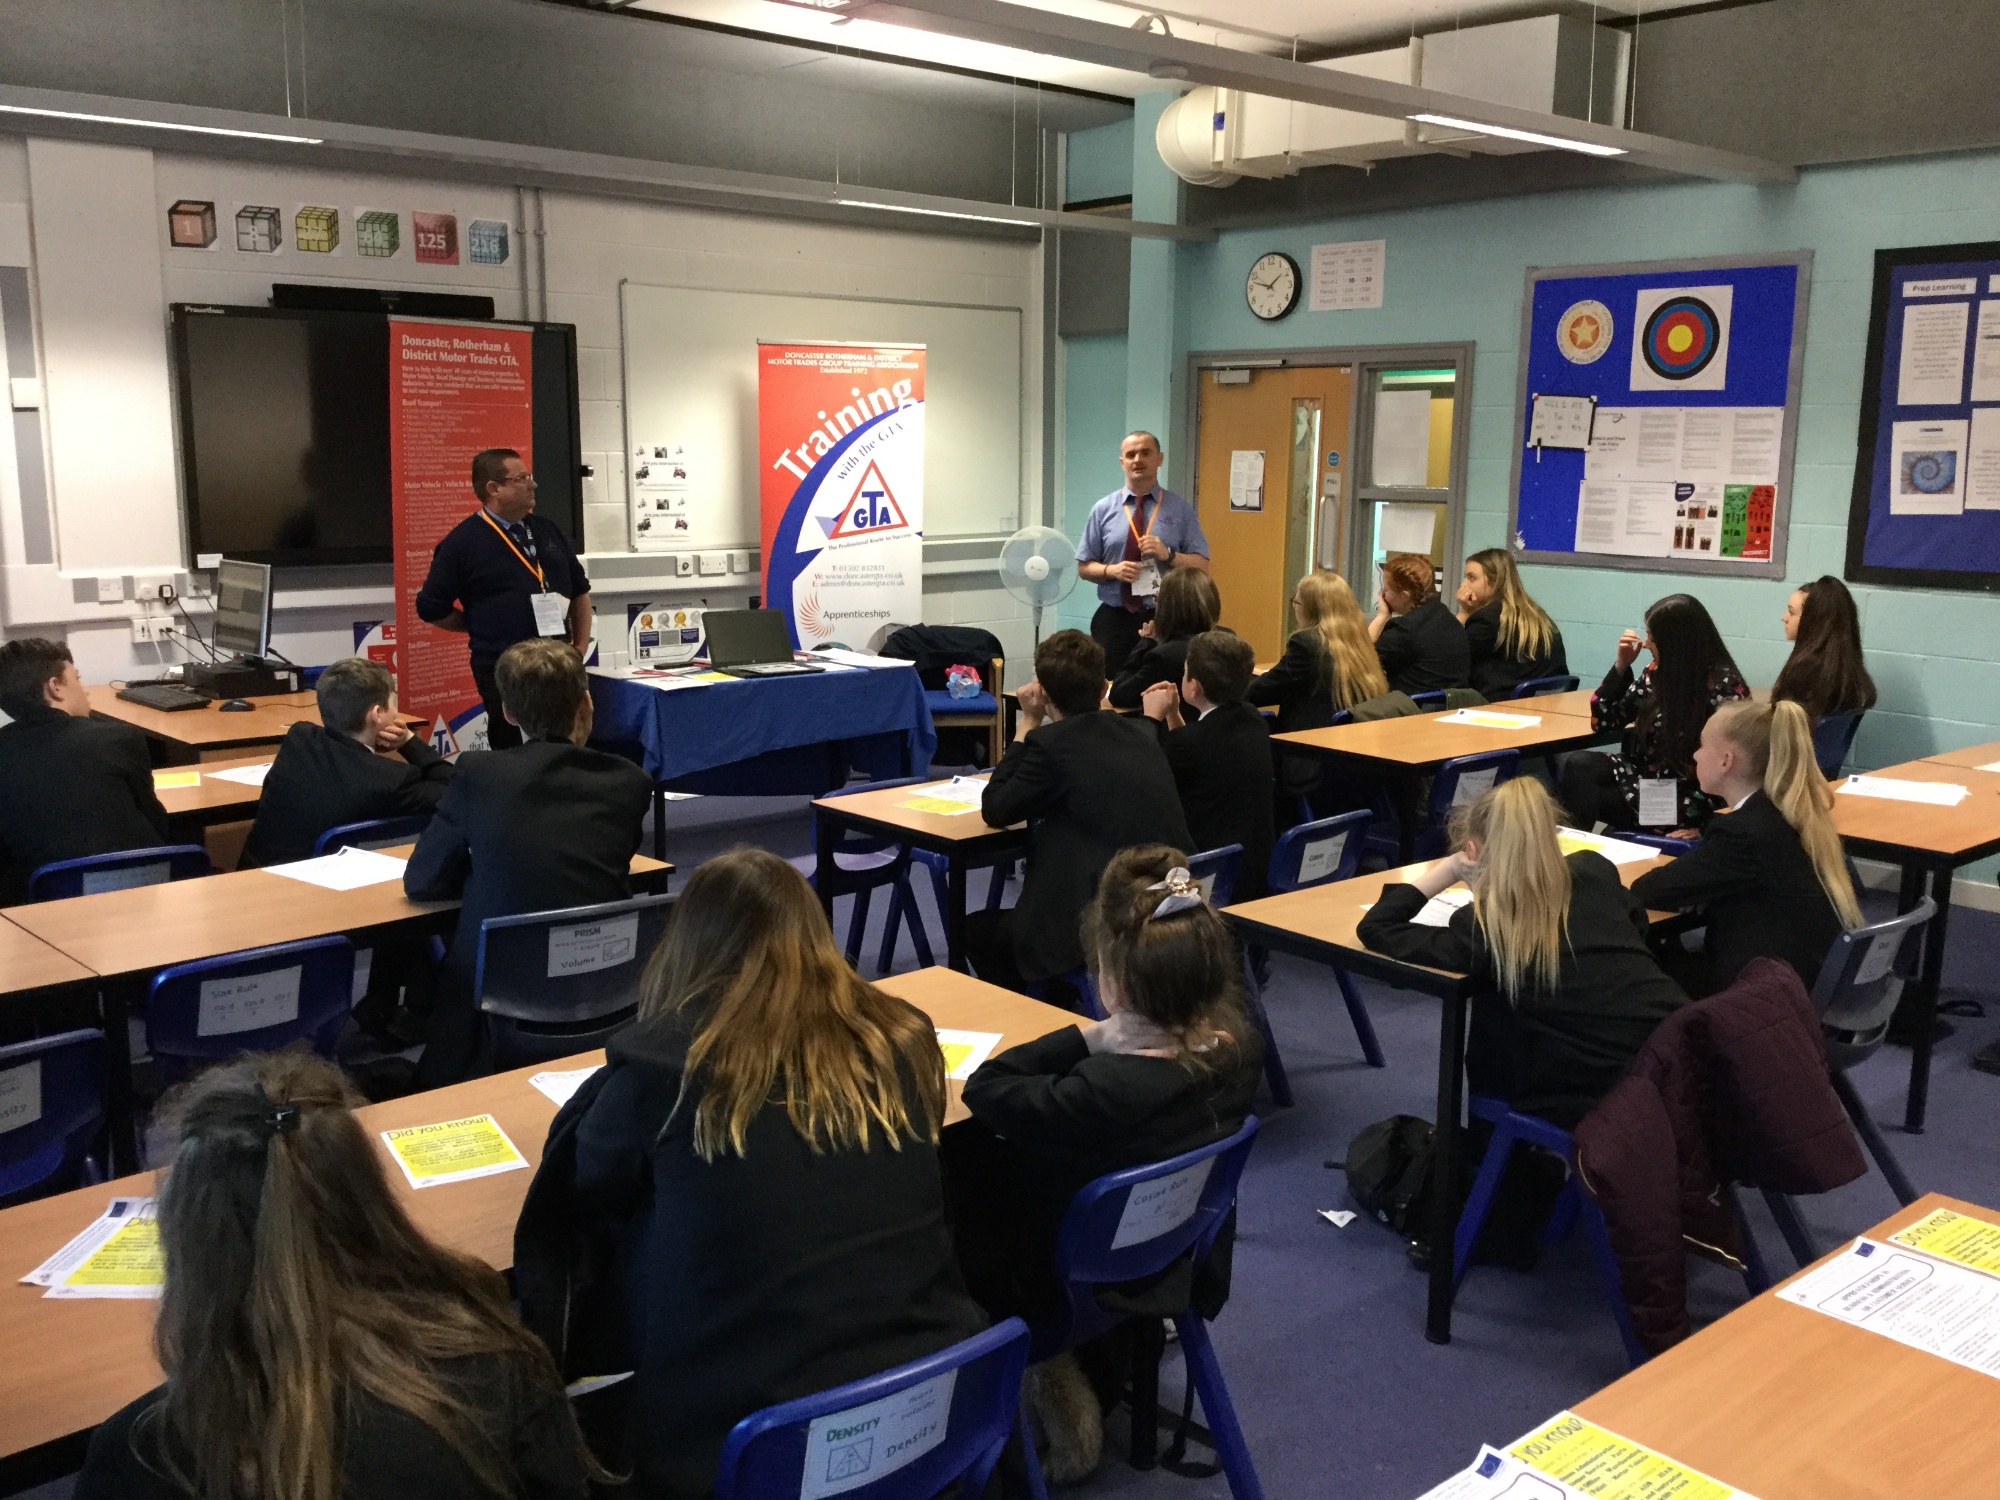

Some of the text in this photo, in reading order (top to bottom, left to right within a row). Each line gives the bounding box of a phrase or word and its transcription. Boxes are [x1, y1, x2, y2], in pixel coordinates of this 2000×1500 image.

[418, 233, 446, 249] 125
[1932, 284, 1966, 292] Learning
[402, 334, 511, 352] Doncaster, Rotherham &
[402, 348, 520, 366] District Motor Trades GTA.
[773, 378, 918, 481] Training
[838, 422, 904, 480] with the GTA
[854, 491, 892, 528] GTA
[838, 539, 870, 550] Professional
[820, 580, 905, 588] admin@doncastergta.co.uk
[825, 572, 903, 580] www.doncastergta.co.uk
[823, 609, 891, 621] Apprenticeships
[560, 958, 596, 968] Volume
[236, 983, 258, 994] Rule
[387, 1116, 488, 1140] Did you know?
[826, 1416, 880, 1443] DENSITY
[886, 1421, 938, 1459] Density
